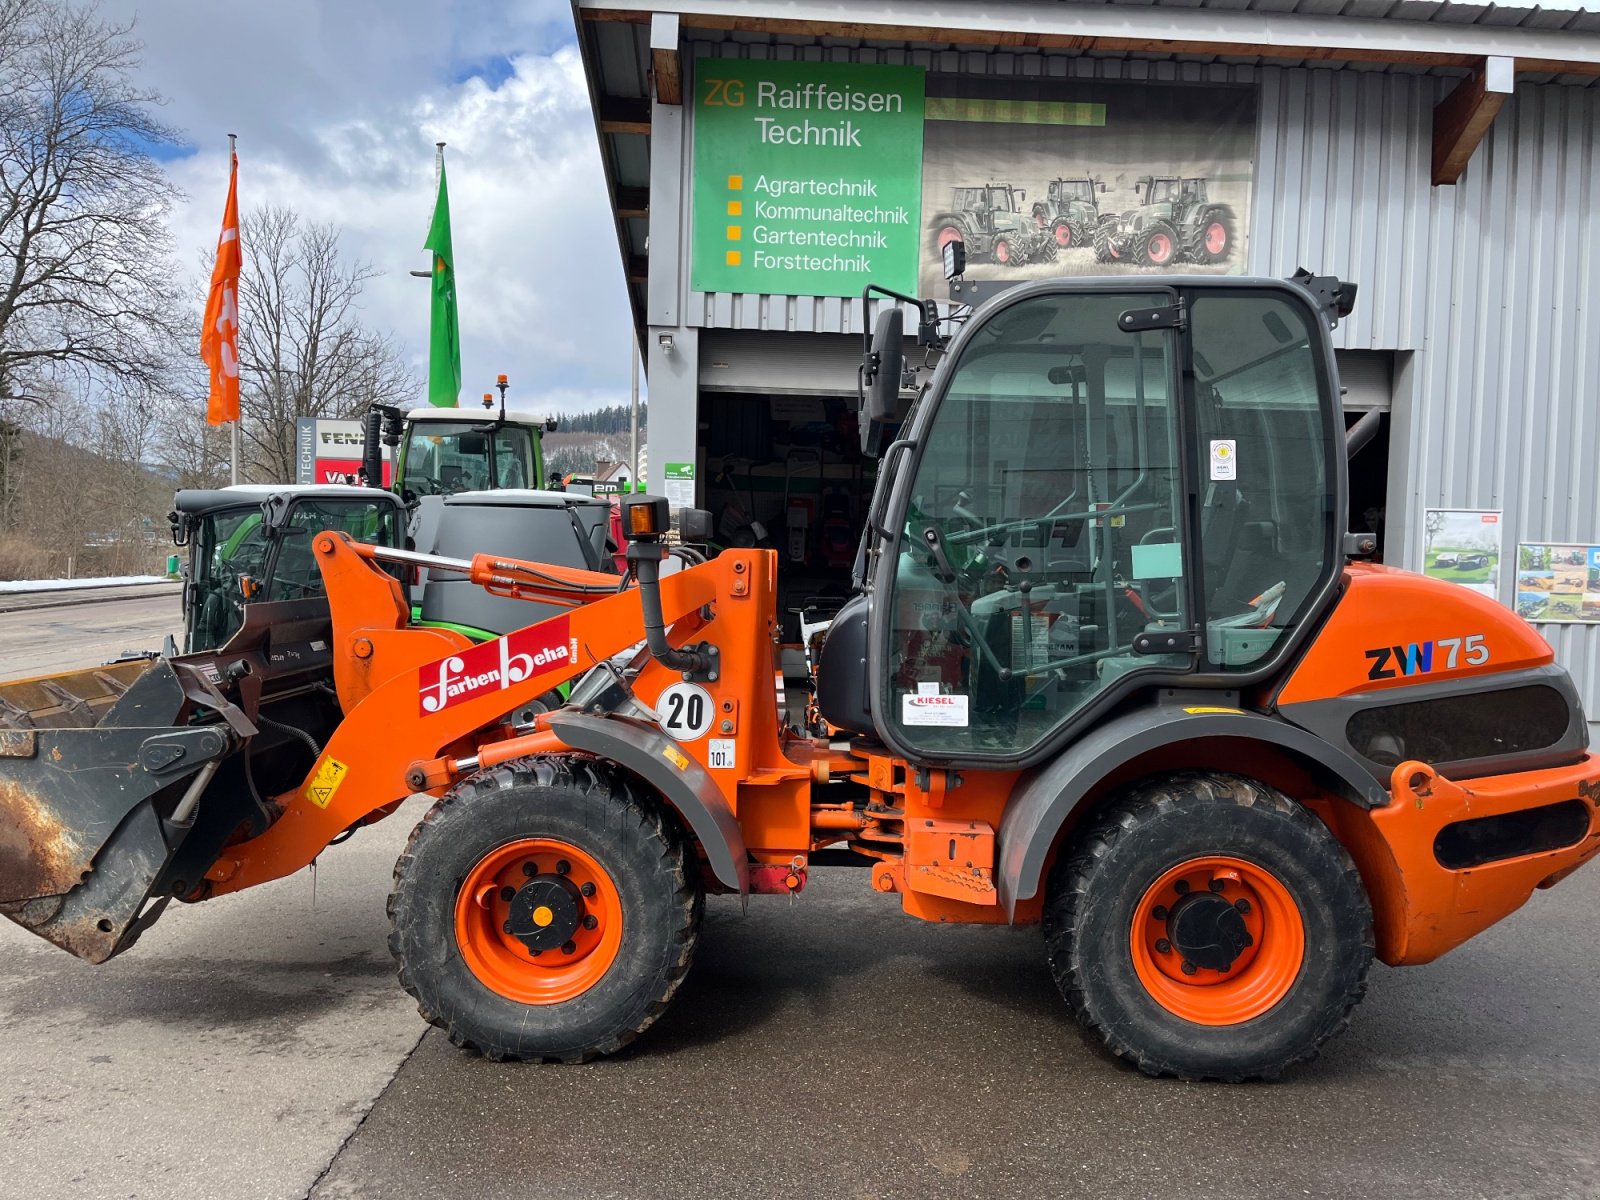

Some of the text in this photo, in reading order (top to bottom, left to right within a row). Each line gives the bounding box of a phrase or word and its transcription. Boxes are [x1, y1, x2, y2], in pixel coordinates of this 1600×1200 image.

[703, 79, 745, 107] ZG
[757, 81, 902, 113] Raiffeisen
[754, 116, 862, 147] Technik
[753, 174, 878, 198] Agrartechnik
[755, 200, 909, 225] Kommunaltechnik
[753, 225, 888, 249] Gartentechnik
[753, 251, 872, 273] Forsttechnik
[301, 425, 312, 477] TECHNIK
[570, 637, 578, 664] GmbH
[1364, 633, 1490, 681] ZW 75
[666, 692, 704, 730] 20
[711, 751, 726, 766] 101
